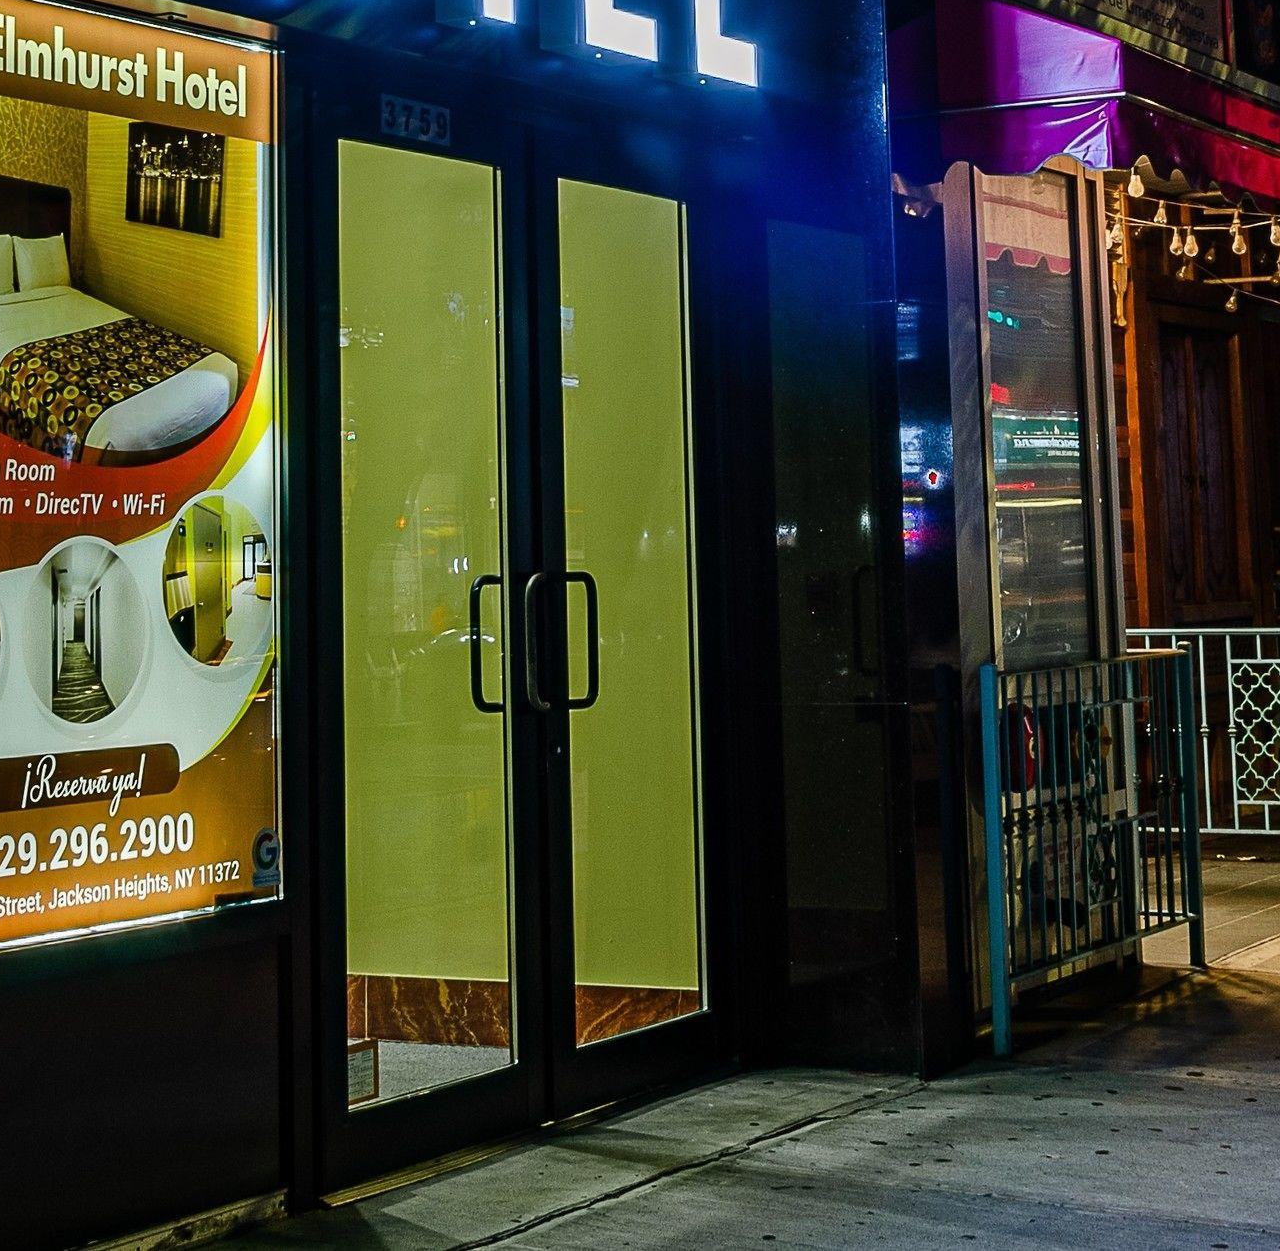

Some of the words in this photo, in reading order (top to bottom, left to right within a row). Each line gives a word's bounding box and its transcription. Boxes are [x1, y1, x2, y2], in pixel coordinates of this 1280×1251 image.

[157, 50, 247, 117] Hotel
[5, 460, 55, 482] Room
[35, 493, 102, 516] DirecTV
[122, 494, 166, 516] Wi-Fi
[48, 882, 110, 910] Jackson
[114, 874, 172, 901] Heights,
[175, 868, 195, 890] NY
[199, 859, 240, 886] 11372
